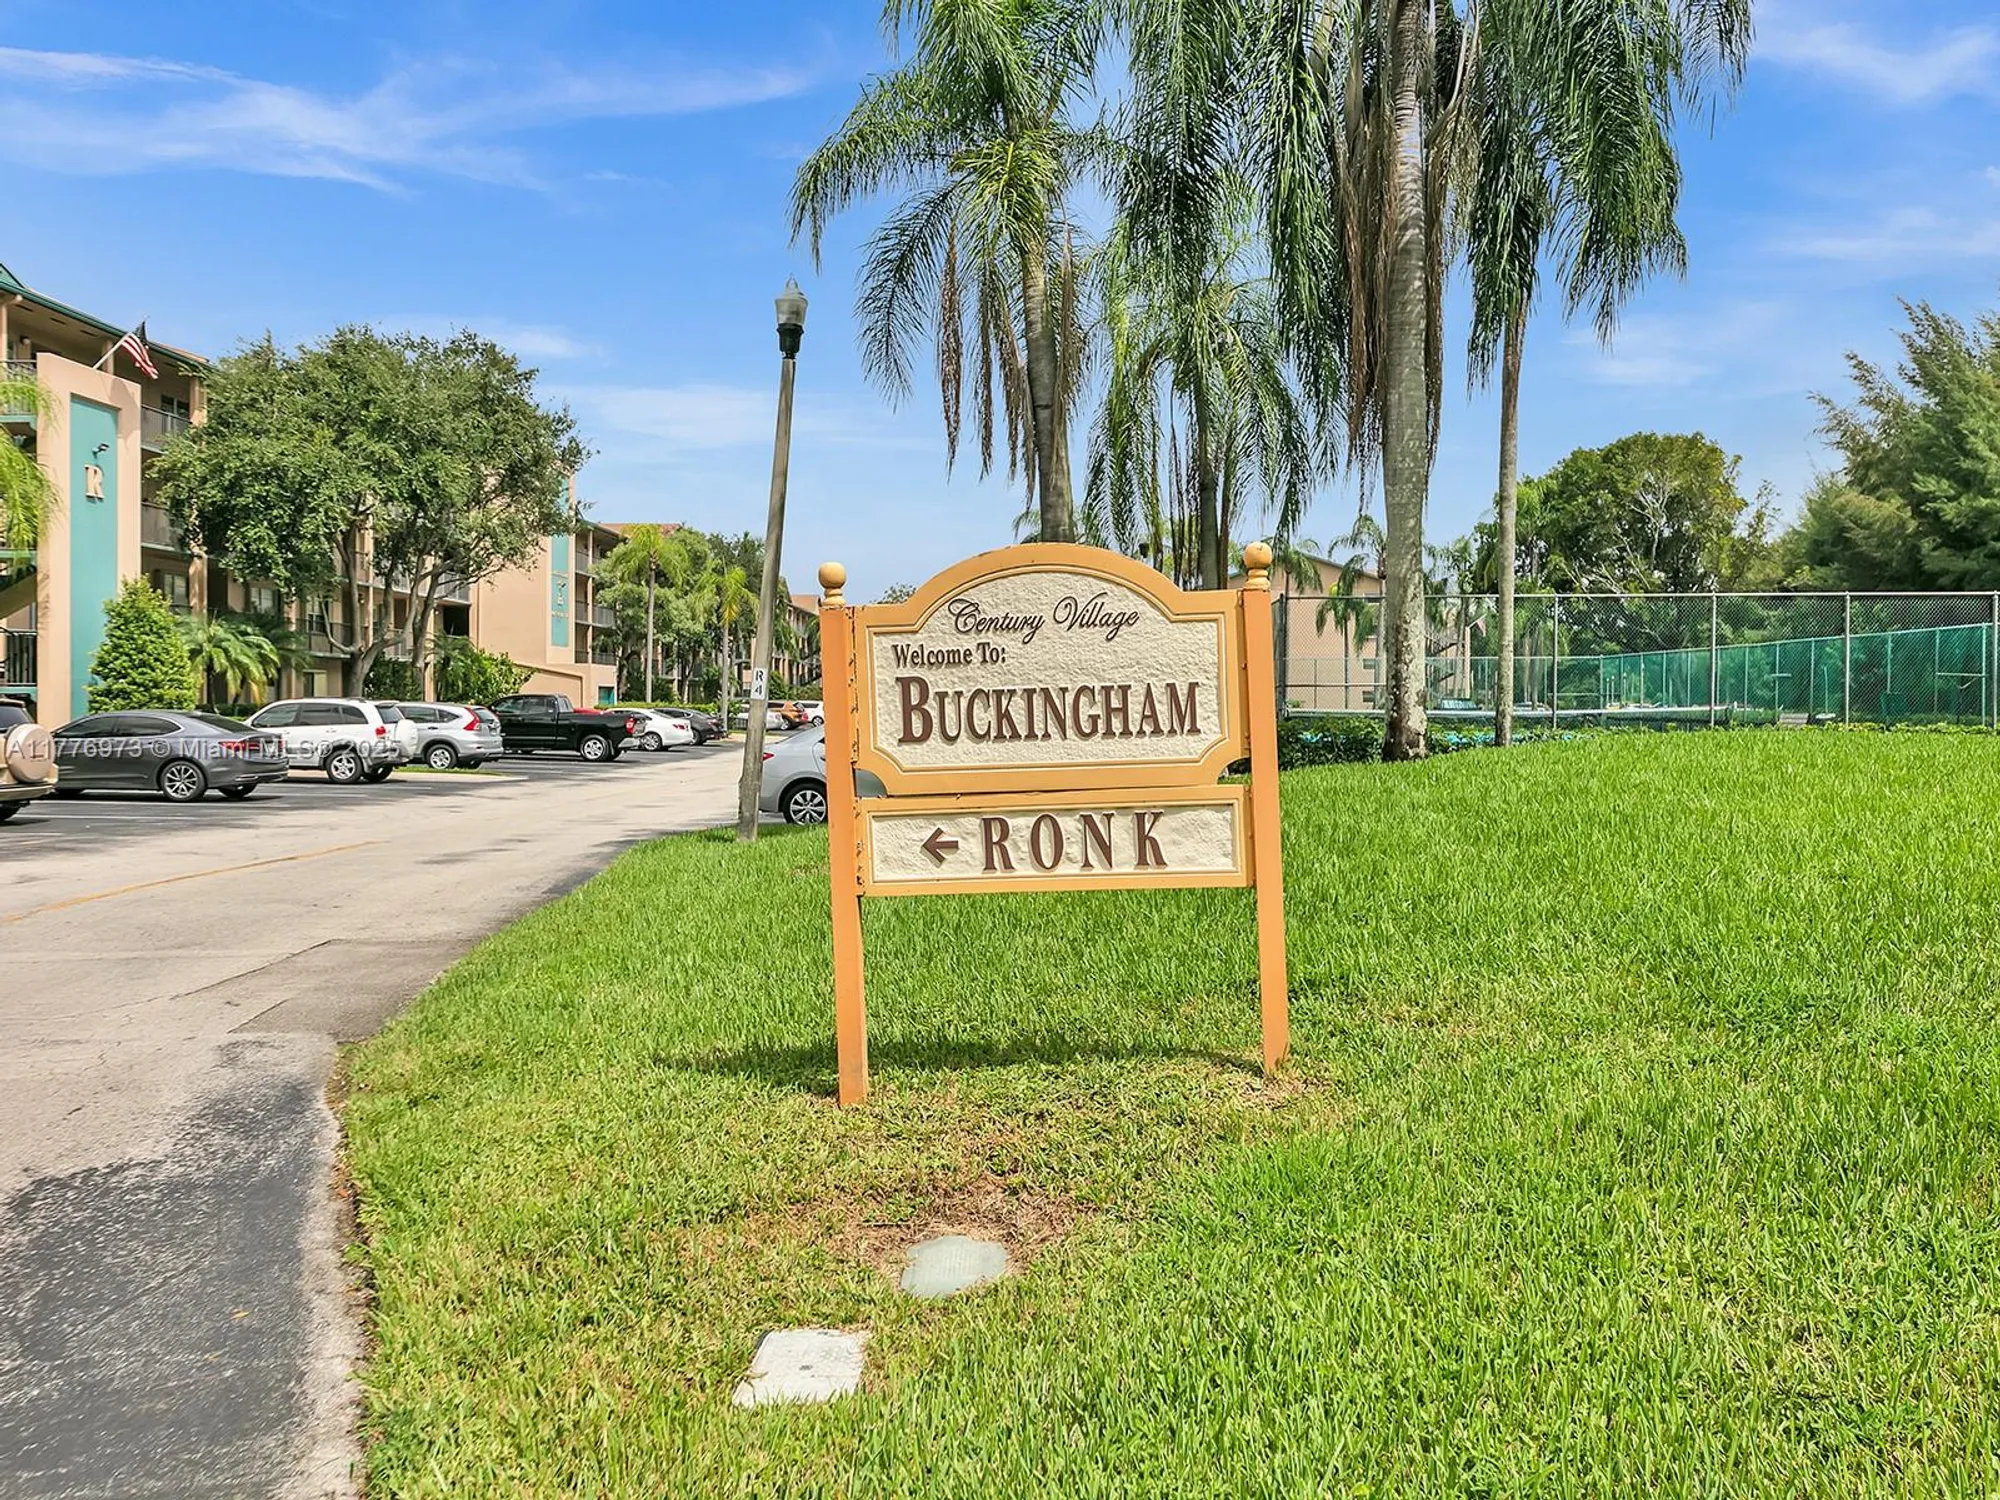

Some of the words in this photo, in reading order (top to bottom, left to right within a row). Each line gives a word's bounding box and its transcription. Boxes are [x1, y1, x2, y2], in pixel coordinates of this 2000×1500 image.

[84, 464, 105, 499] R
[947, 598, 1045, 643] Century
[1053, 592, 1140, 642] Village
[755, 670, 764, 681] R
[891, 643, 973, 670] Welcome
[976, 642, 1007, 665] To:
[895, 675, 1202, 744] BUCKINGHAM
[980, 810, 1168, 872] RONK
